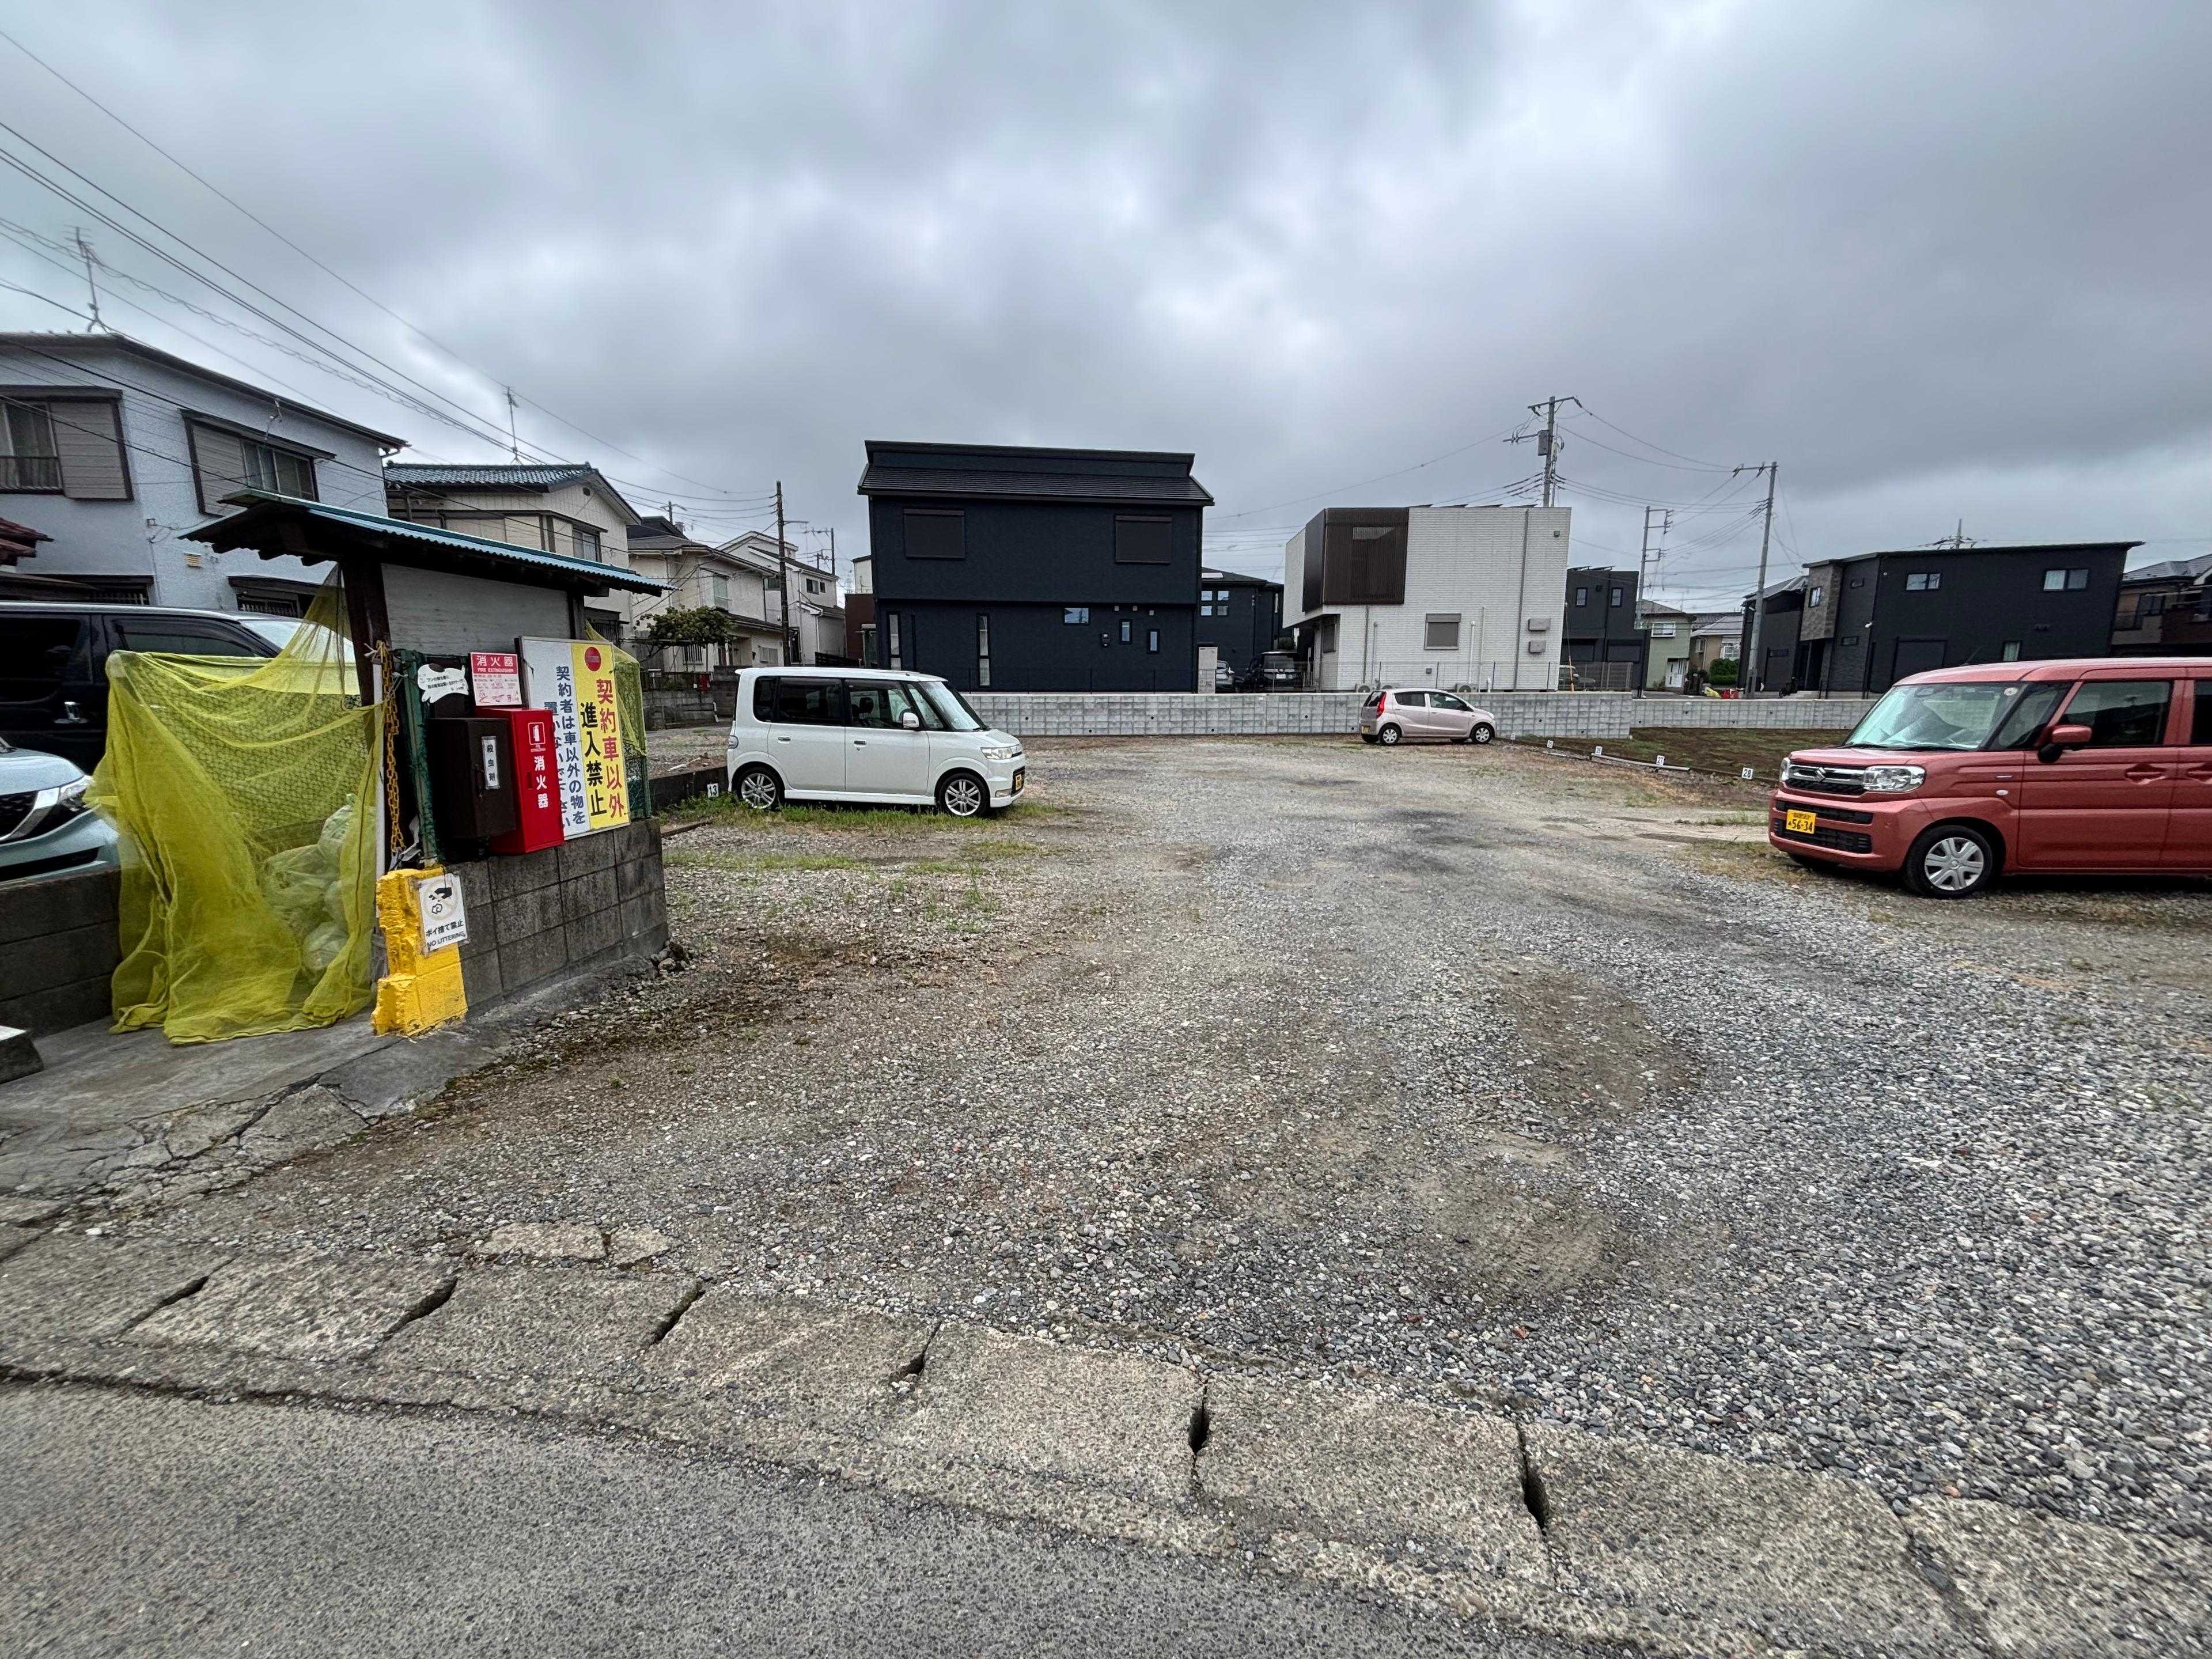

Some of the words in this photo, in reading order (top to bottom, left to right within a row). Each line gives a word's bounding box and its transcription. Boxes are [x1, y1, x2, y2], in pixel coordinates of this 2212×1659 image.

[476, 655, 514, 667] 消火器
[556, 665, 585, 825] 契約者は車以外の物を
[596, 679, 624, 819] 契約車以外
[486, 744, 495, 781] 殺虫剤
[580, 702, 607, 816] 進入禁止
[1657, 756, 1664, 764] 27
[534, 755, 548, 809] 消火器
[1743, 768, 1752, 778] 28
[709, 785, 717, 796] 13
[1792, 819, 1813, 832] 56-34
[426, 919, 464, 937] ポイ捨て禁止
